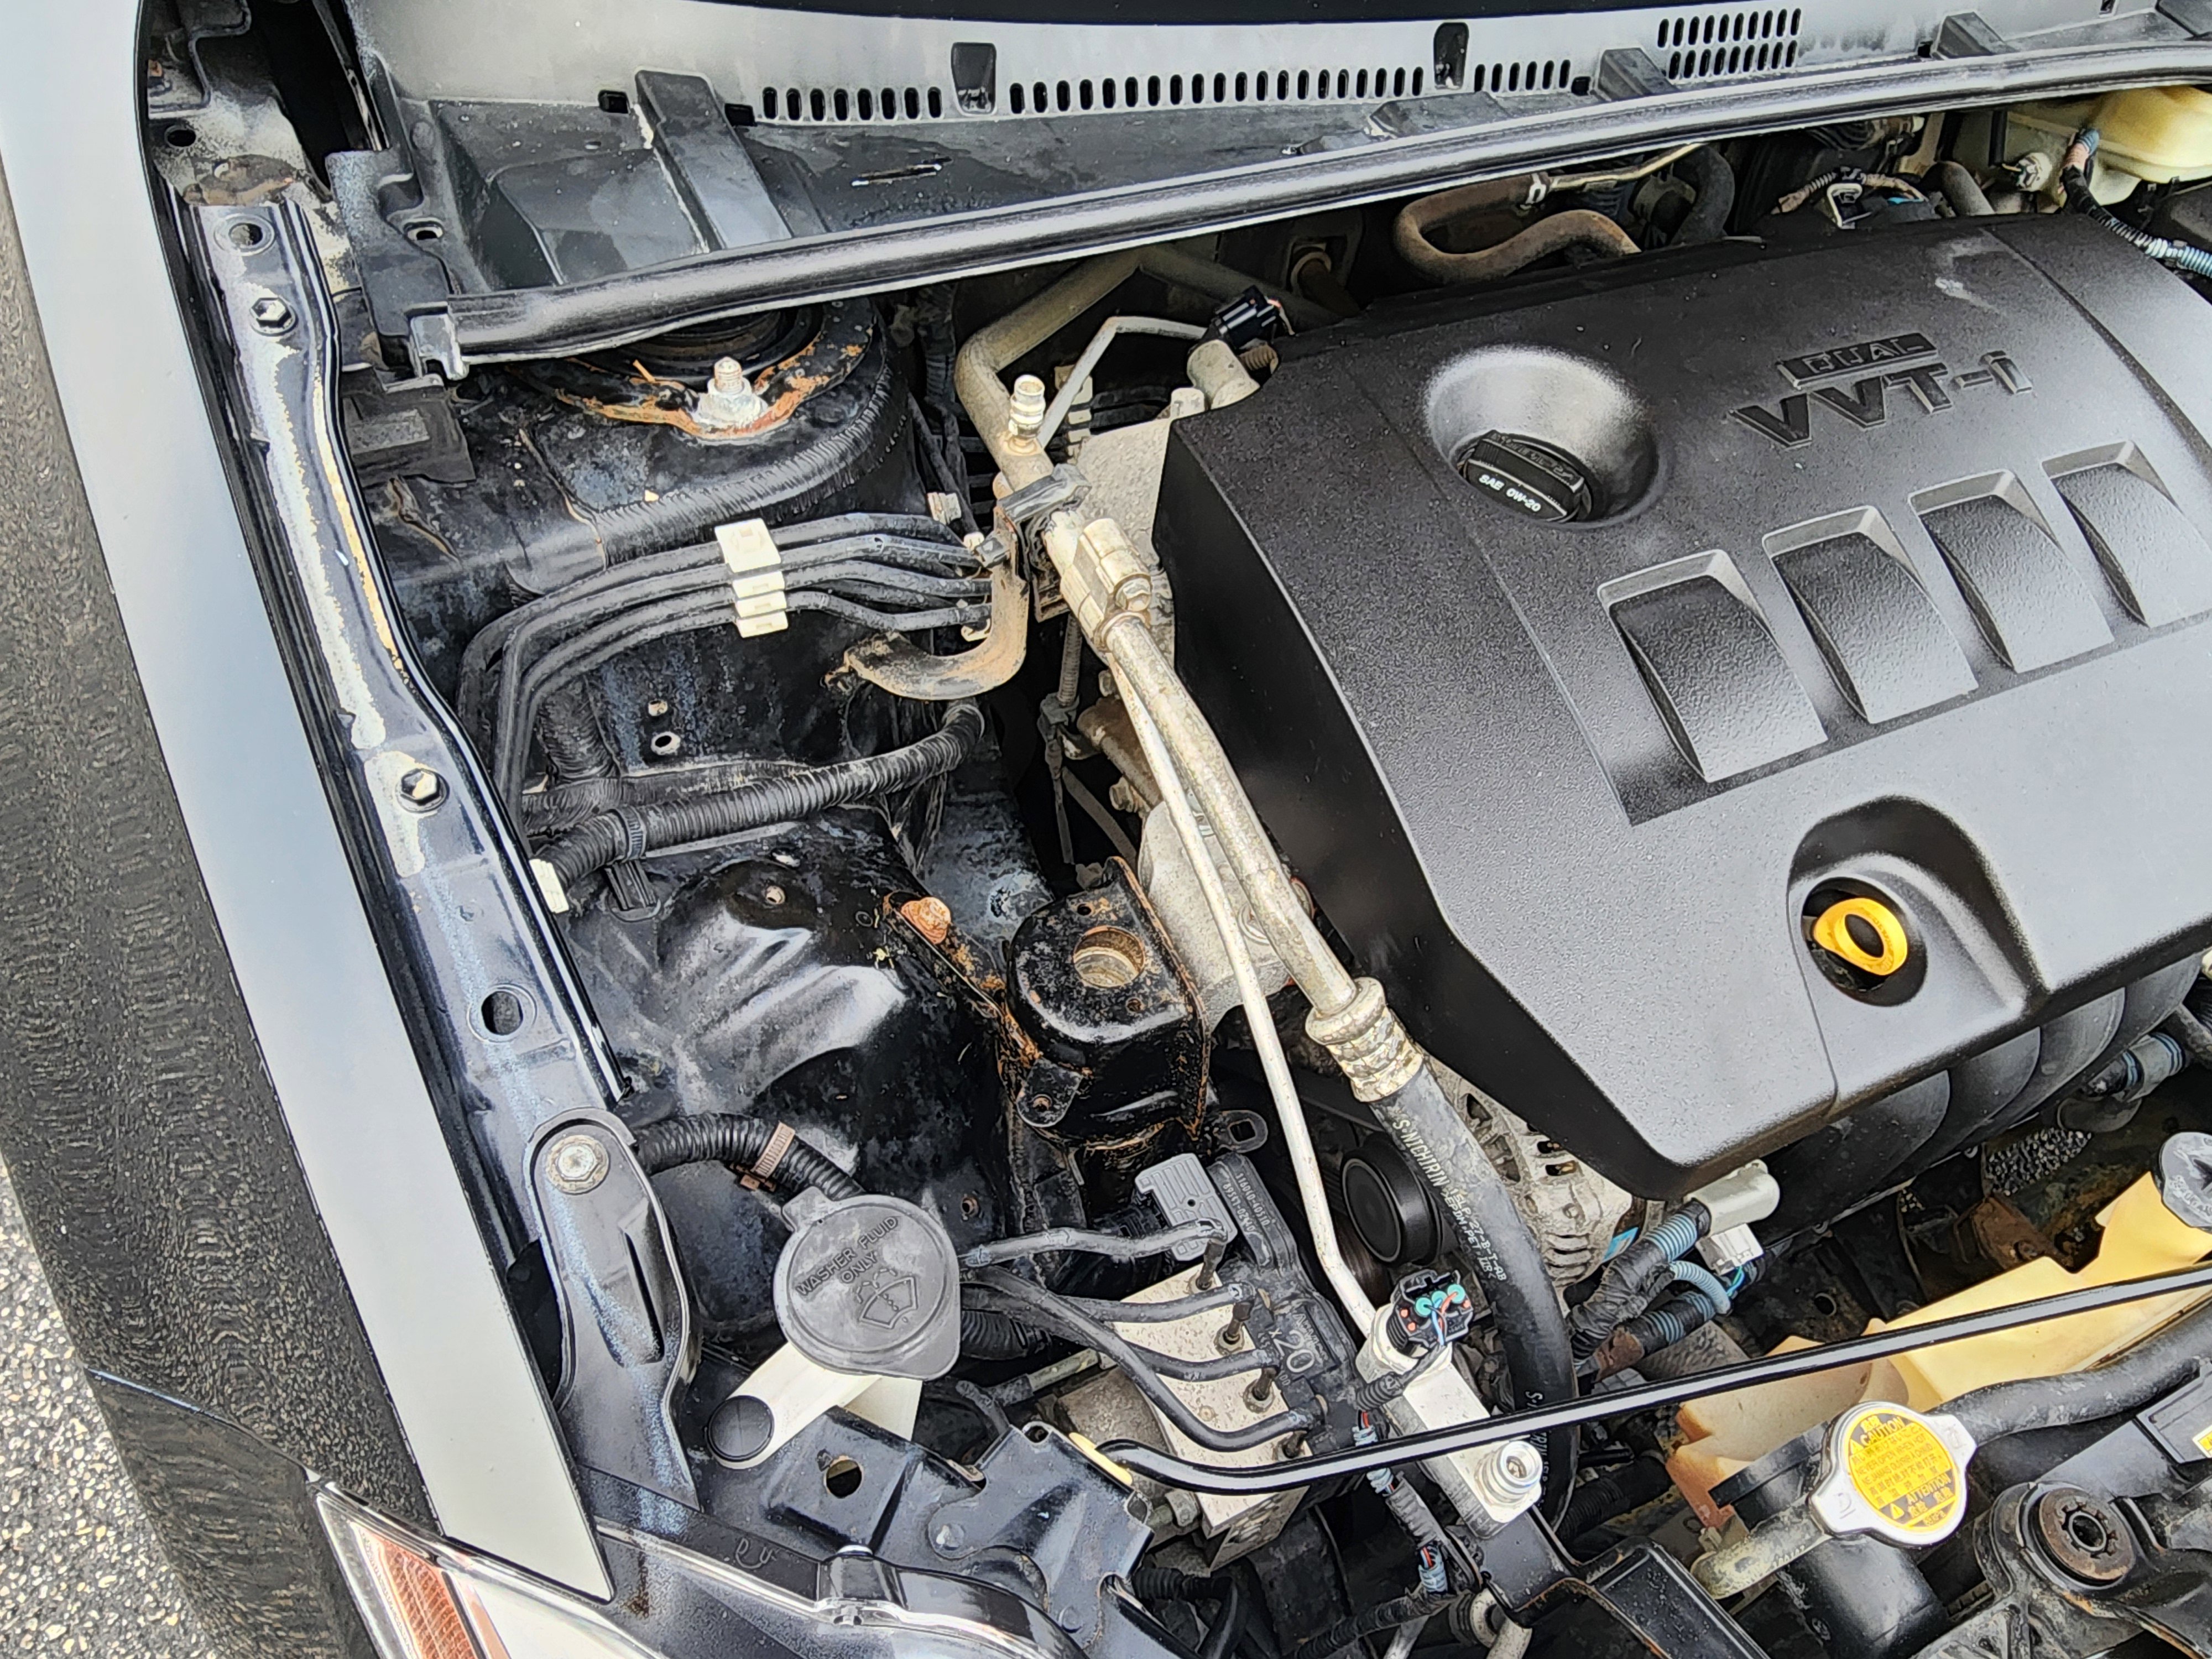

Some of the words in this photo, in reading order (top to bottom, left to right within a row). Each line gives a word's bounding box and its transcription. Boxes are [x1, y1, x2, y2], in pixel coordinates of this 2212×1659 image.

[1804, 336, 1923, 375] DUAL
[1728, 351, 2035, 450] VVT-i
[1479, 474, 1504, 491] SAE
[1506, 487, 1542, 512] 0W-20
[796, 1248, 855, 1297] WASHER
[858, 1215, 899, 1250] FLUID
[841, 1251, 878, 1284] ONLY
[1860, 1416, 1905, 1447] CAUTION
[1877, 1450, 1896, 1464] OPEN
[1895, 1440, 1914, 1454] WHEN
[1913, 1433, 1926, 1444] HOT
[1904, 1473, 1952, 1505] ATTENTION
